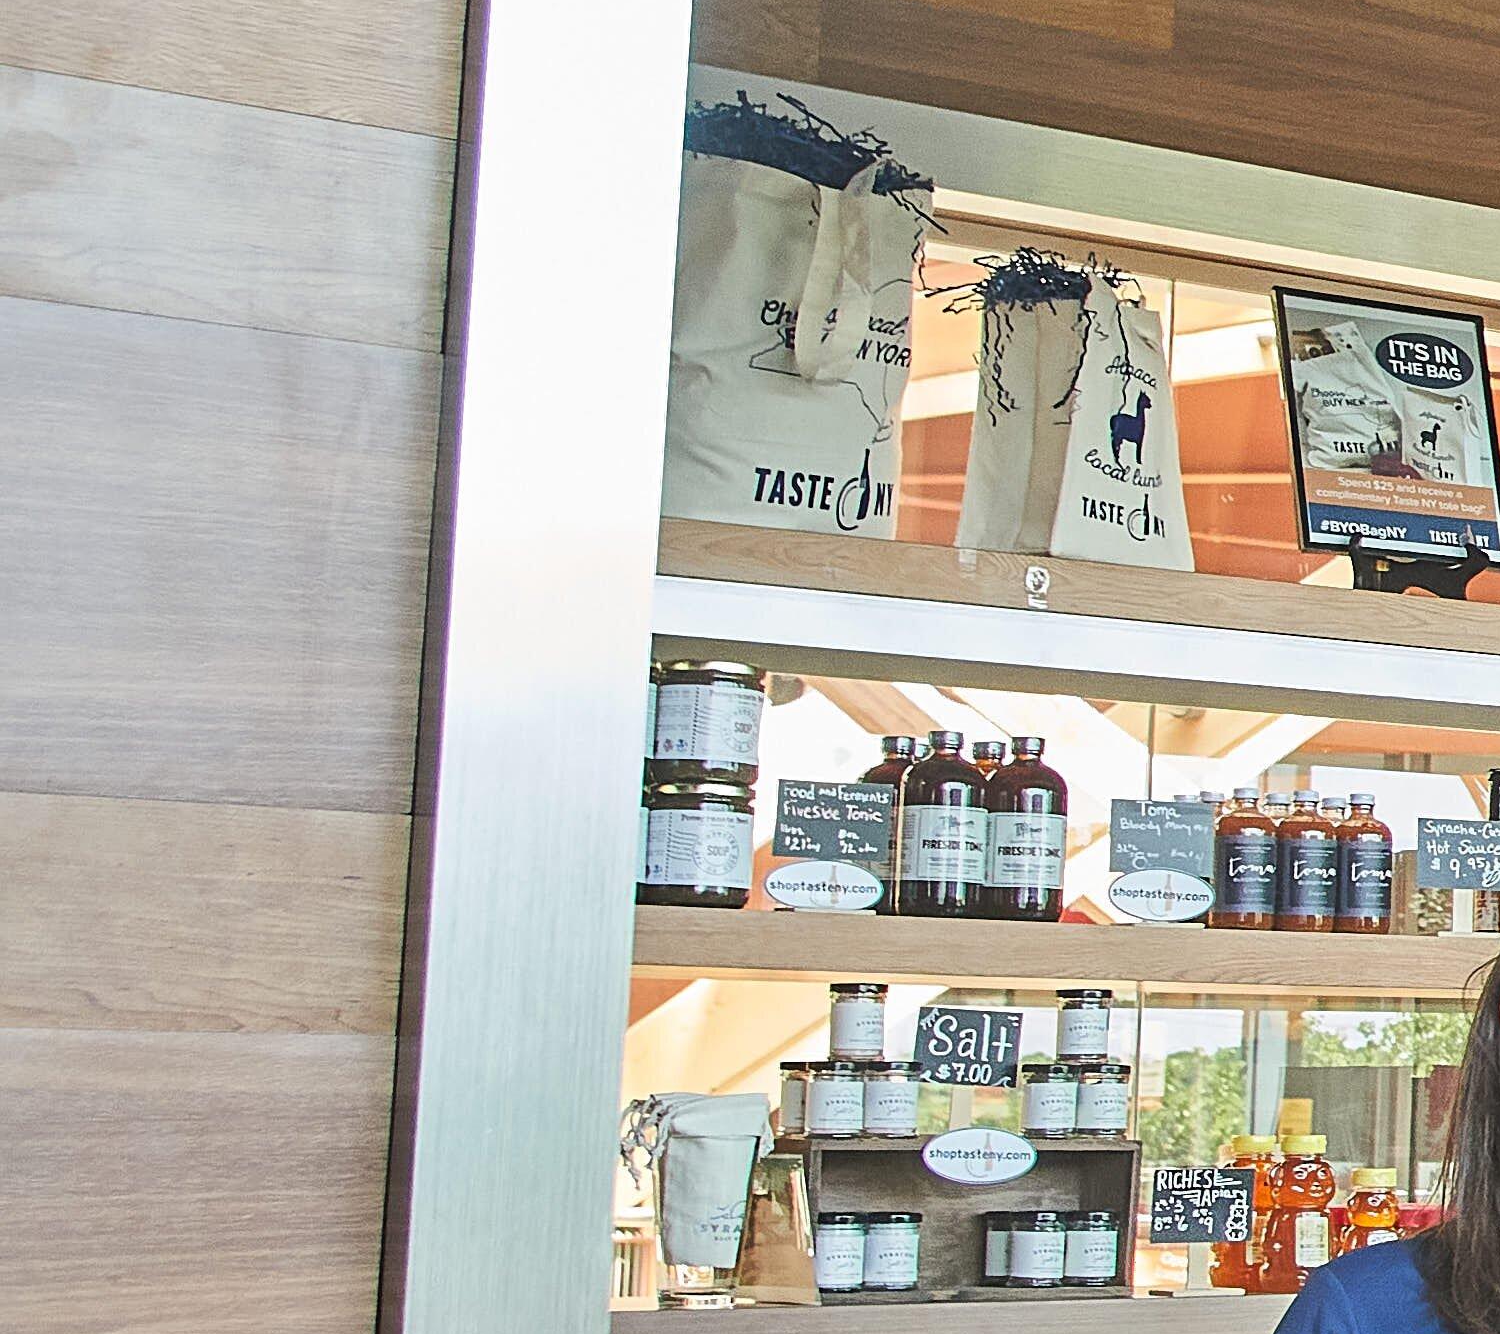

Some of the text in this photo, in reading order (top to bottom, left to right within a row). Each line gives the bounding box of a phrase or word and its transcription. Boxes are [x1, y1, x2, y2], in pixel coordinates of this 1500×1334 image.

[1388, 339, 1459, 365] IT'S IN
[1388, 359, 1463, 381] THE BAG
[1333, 441, 1366, 454] TASTE
[1085, 448, 1130, 483] local
[754, 467, 894, 516] TASTE NY
[1373, 480, 1394, 491] $25
[1082, 496, 1124, 526] TASTE
[1429, 530, 1458, 544] TASTE
[784, 782, 815, 800] Food
[846, 804, 884, 823] Tonic
[1136, 801, 1181, 820] Toma
[1426, 839, 1450, 856] Hot
[769, 880, 878, 895] shoptasteny.com
[1112, 887, 1210, 902] shoptasteny.com
[928, 1013, 1013, 1062] Salt
[935, 1063, 992, 1086] $7.00
[929, 1147, 1032, 1163] shoptasteny.com
